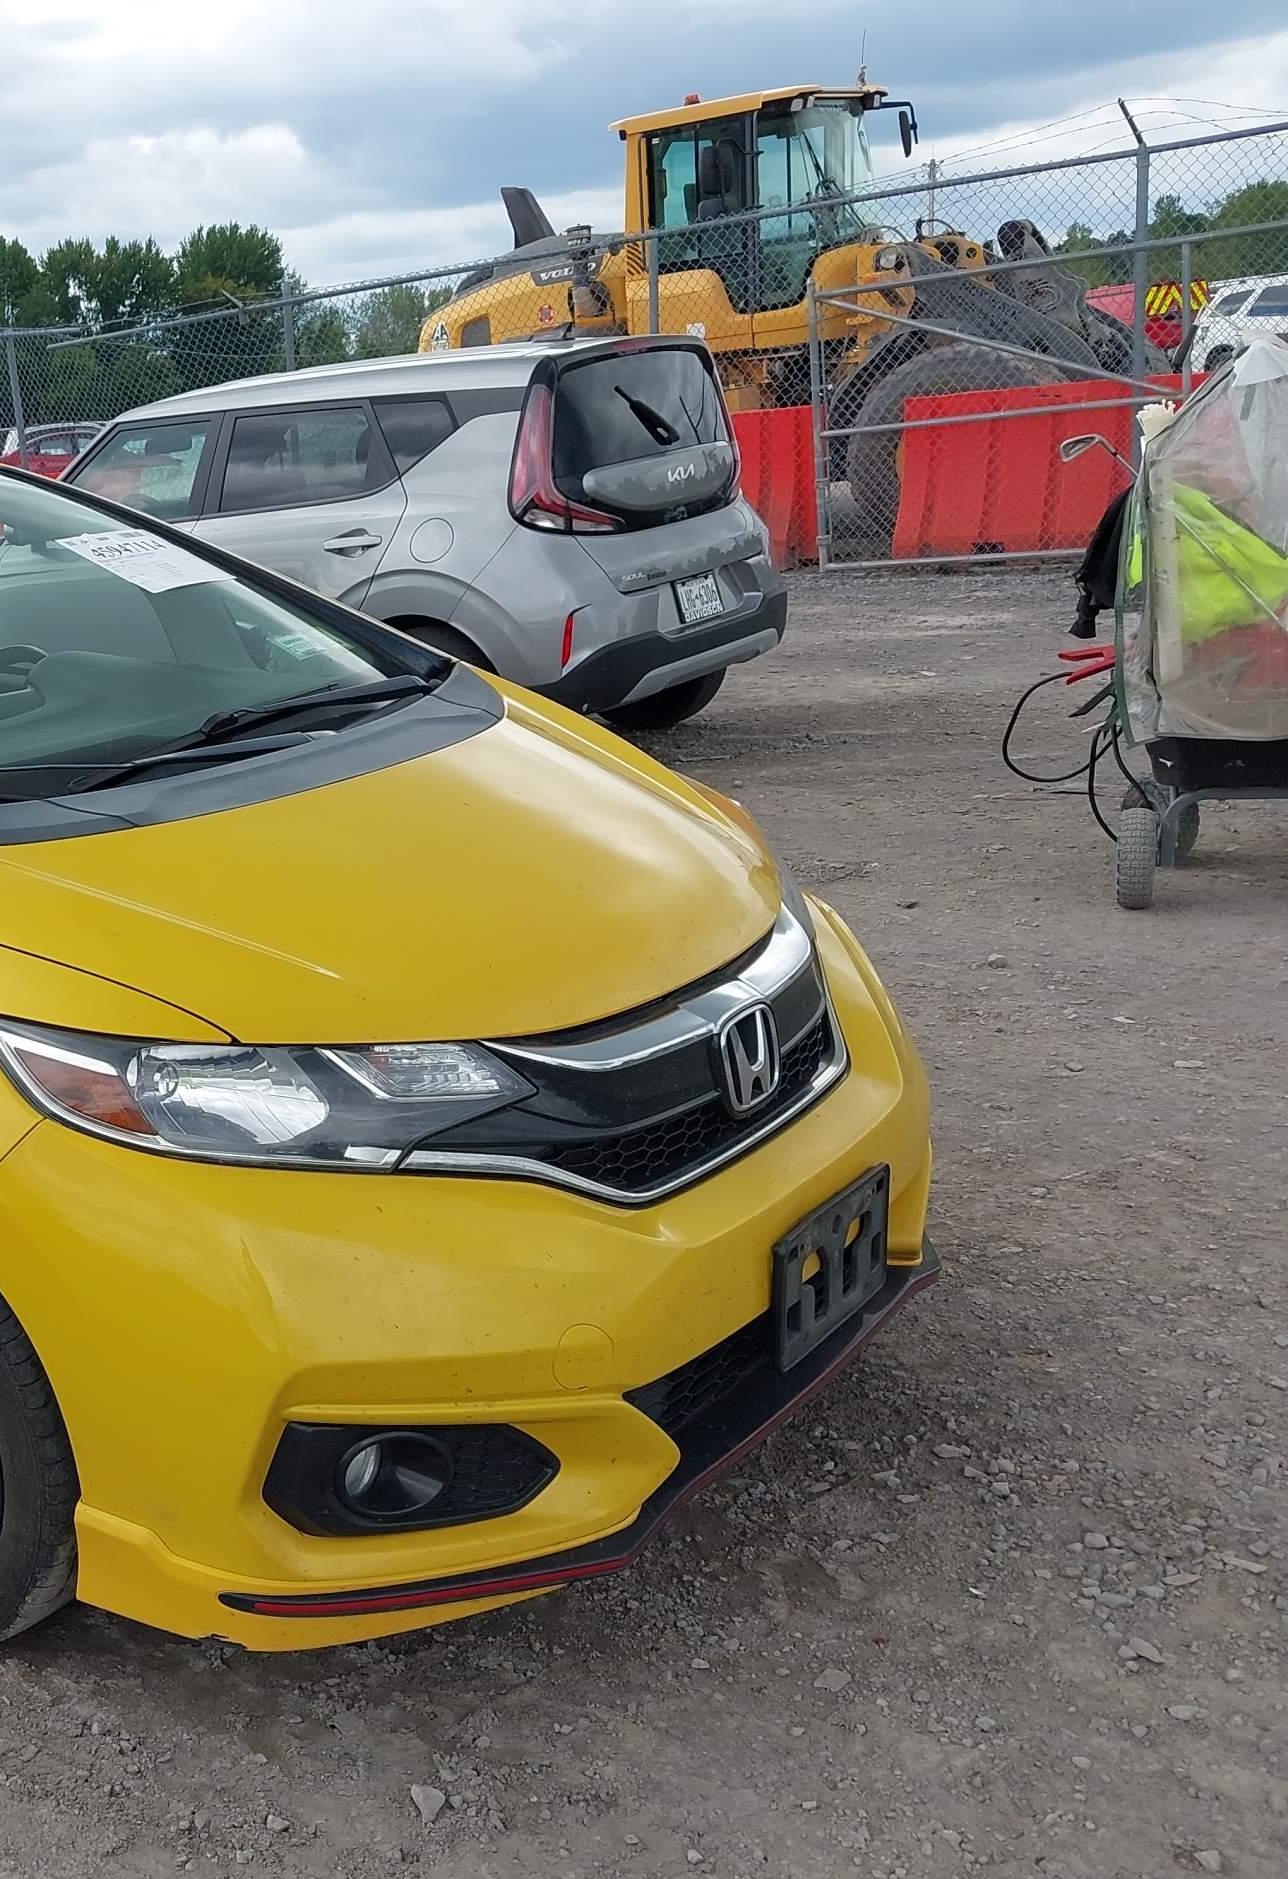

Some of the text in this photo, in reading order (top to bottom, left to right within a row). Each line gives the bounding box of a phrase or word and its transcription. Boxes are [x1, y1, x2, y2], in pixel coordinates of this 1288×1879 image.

[539, 262, 597, 281] VOLO
[667, 463, 695, 482] KIA
[91, 540, 167, 558] 45947114
